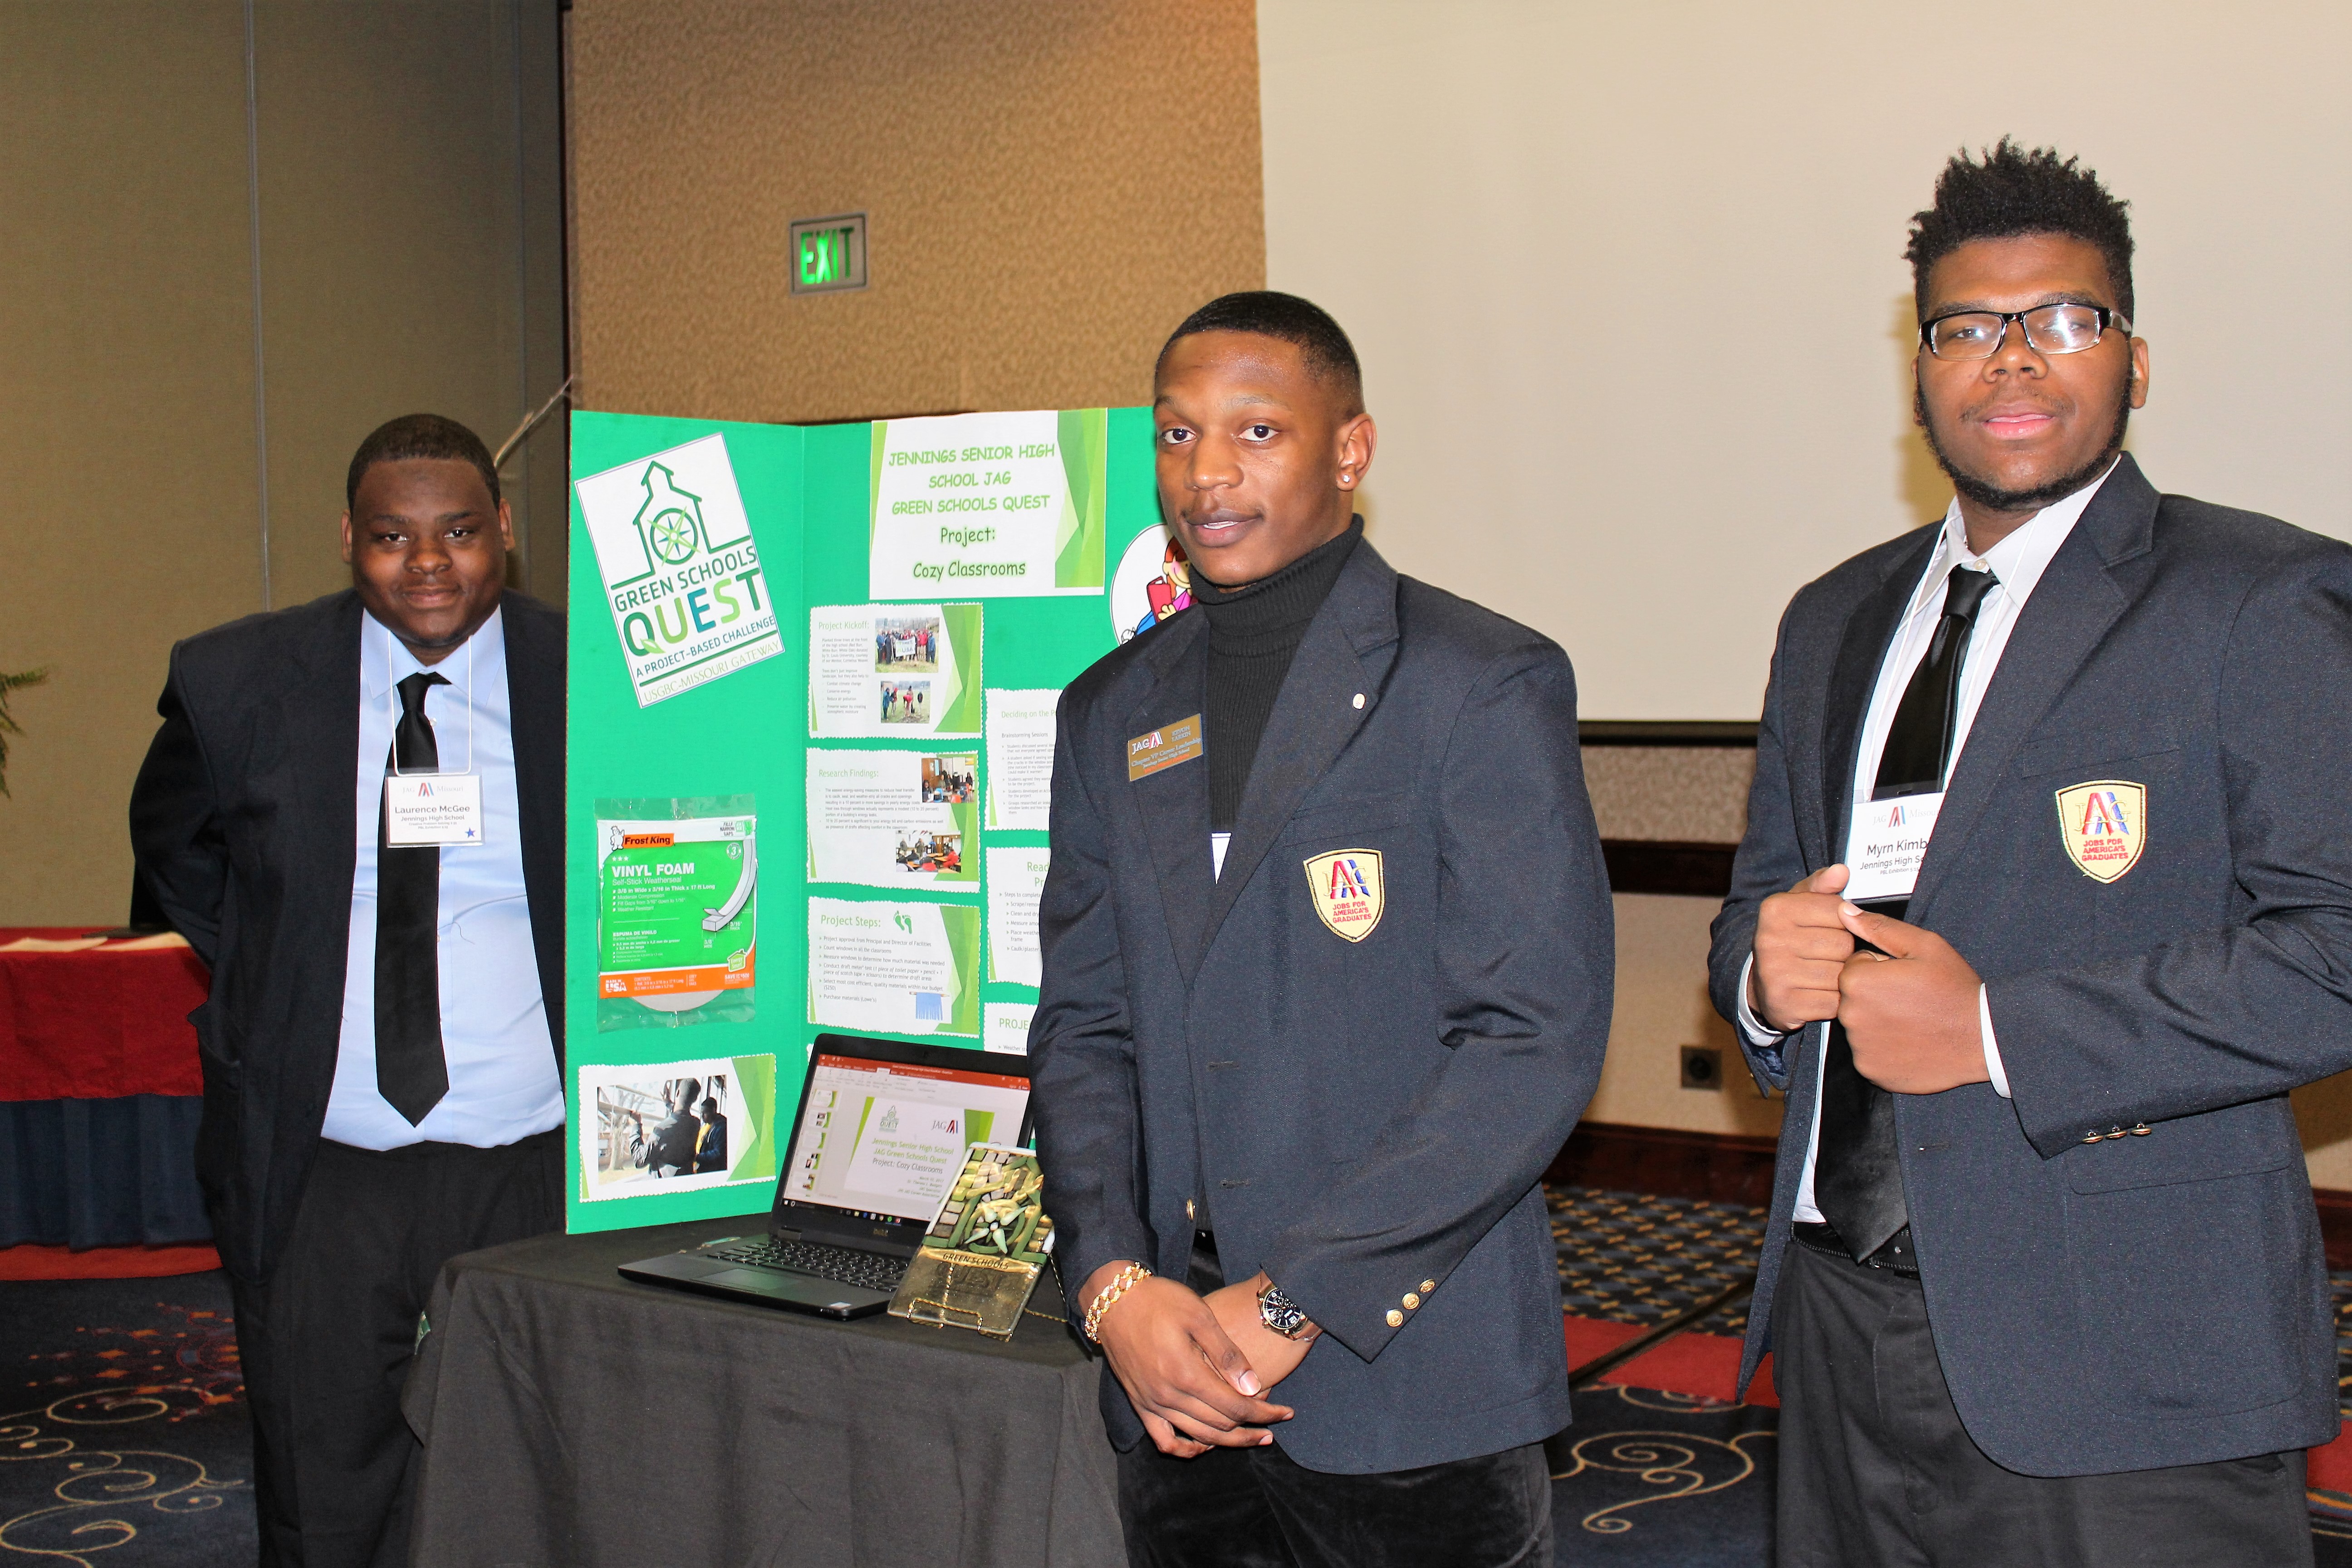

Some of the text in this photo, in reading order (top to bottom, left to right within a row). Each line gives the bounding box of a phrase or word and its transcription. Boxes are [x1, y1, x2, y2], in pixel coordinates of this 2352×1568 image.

[801, 227, 854, 284] EXIT
[889, 443, 1055, 466] JENNINGS SENIOR HIGH
[929, 470, 1012, 489] SCHOOL JAG
[892, 495, 1050, 515] GREEN SCHOOLS QUEST
[940, 527, 995, 548] Project:
[615, 545, 757, 612] GREEN SCHOOLS
[913, 561, 1026, 583] Cozy Classrooms
[623, 568, 760, 656] QUEST
[818, 621, 869, 632] Project Kickoff:
[637, 615, 775, 678] A PROJECT-BASED CHALLENGE
[644, 640, 779, 702] USGBC-MISSOURI GATEWAY
[1002, 710, 1028, 719] Deciding
[1132, 739, 1150, 755] JAG
[850, 769, 878, 779] Findings:
[625, 836, 670, 845] Frost King
[731, 846, 736, 855] 3
[1867, 844, 1893, 858] Myrn
[2083, 845, 2126, 853] AMERICA'S
[1860, 859, 1892, 870] Jennings
[1895, 856, 1912, 866] High
[2082, 852, 2129, 861] GRADUATES
[612, 863, 695, 878] VINYL FOAM
[644, 876, 681, 884] Weatherseal
[1333, 907, 1369, 916] AMERICA'S
[1333, 913, 1372, 923] GRADUATES
[821, 915, 881, 929] Project Steps:
[606, 982, 627, 992] USA
[1000, 1018, 1031, 1030] PROJE
[931, 1120, 946, 1130] JAG
[872, 1138, 954, 1155] Jennings Senior High School
[906, 1152, 928, 1161] Schools
[930, 1156, 947, 1164] Quest
[872, 1158, 943, 1174] Project: Cozy Classrooms
[943, 1253, 1009, 1269] GREEN SCHOOLS
